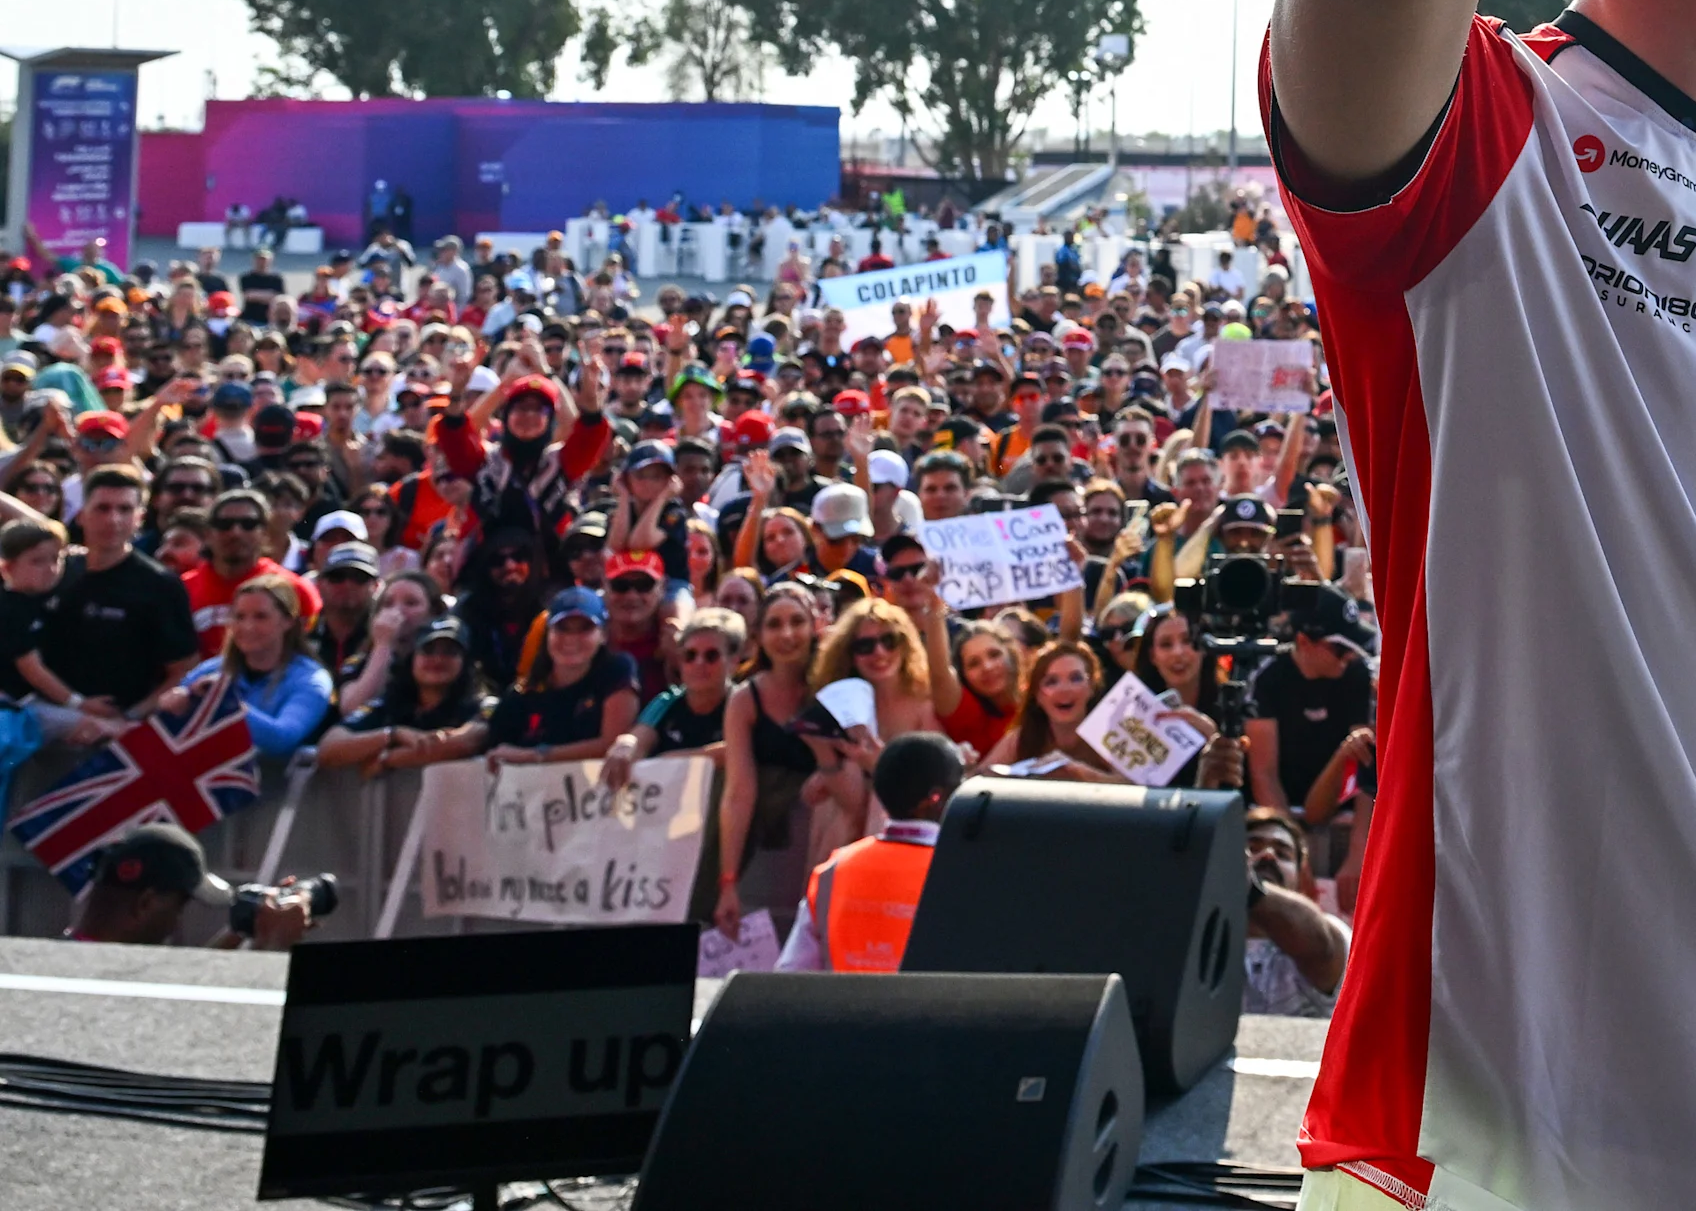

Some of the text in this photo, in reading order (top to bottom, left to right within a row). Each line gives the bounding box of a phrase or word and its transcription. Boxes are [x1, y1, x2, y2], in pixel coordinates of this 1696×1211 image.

[857, 265, 976, 303] COLAPINTO
[1009, 517, 1060, 542] Can
[1009, 540, 1065, 562] your
[939, 573, 1003, 605] CAP
[1101, 730, 1148, 770] CAP
[600, 859, 672, 912] kiss
[281, 1030, 687, 1118] Wrap up
